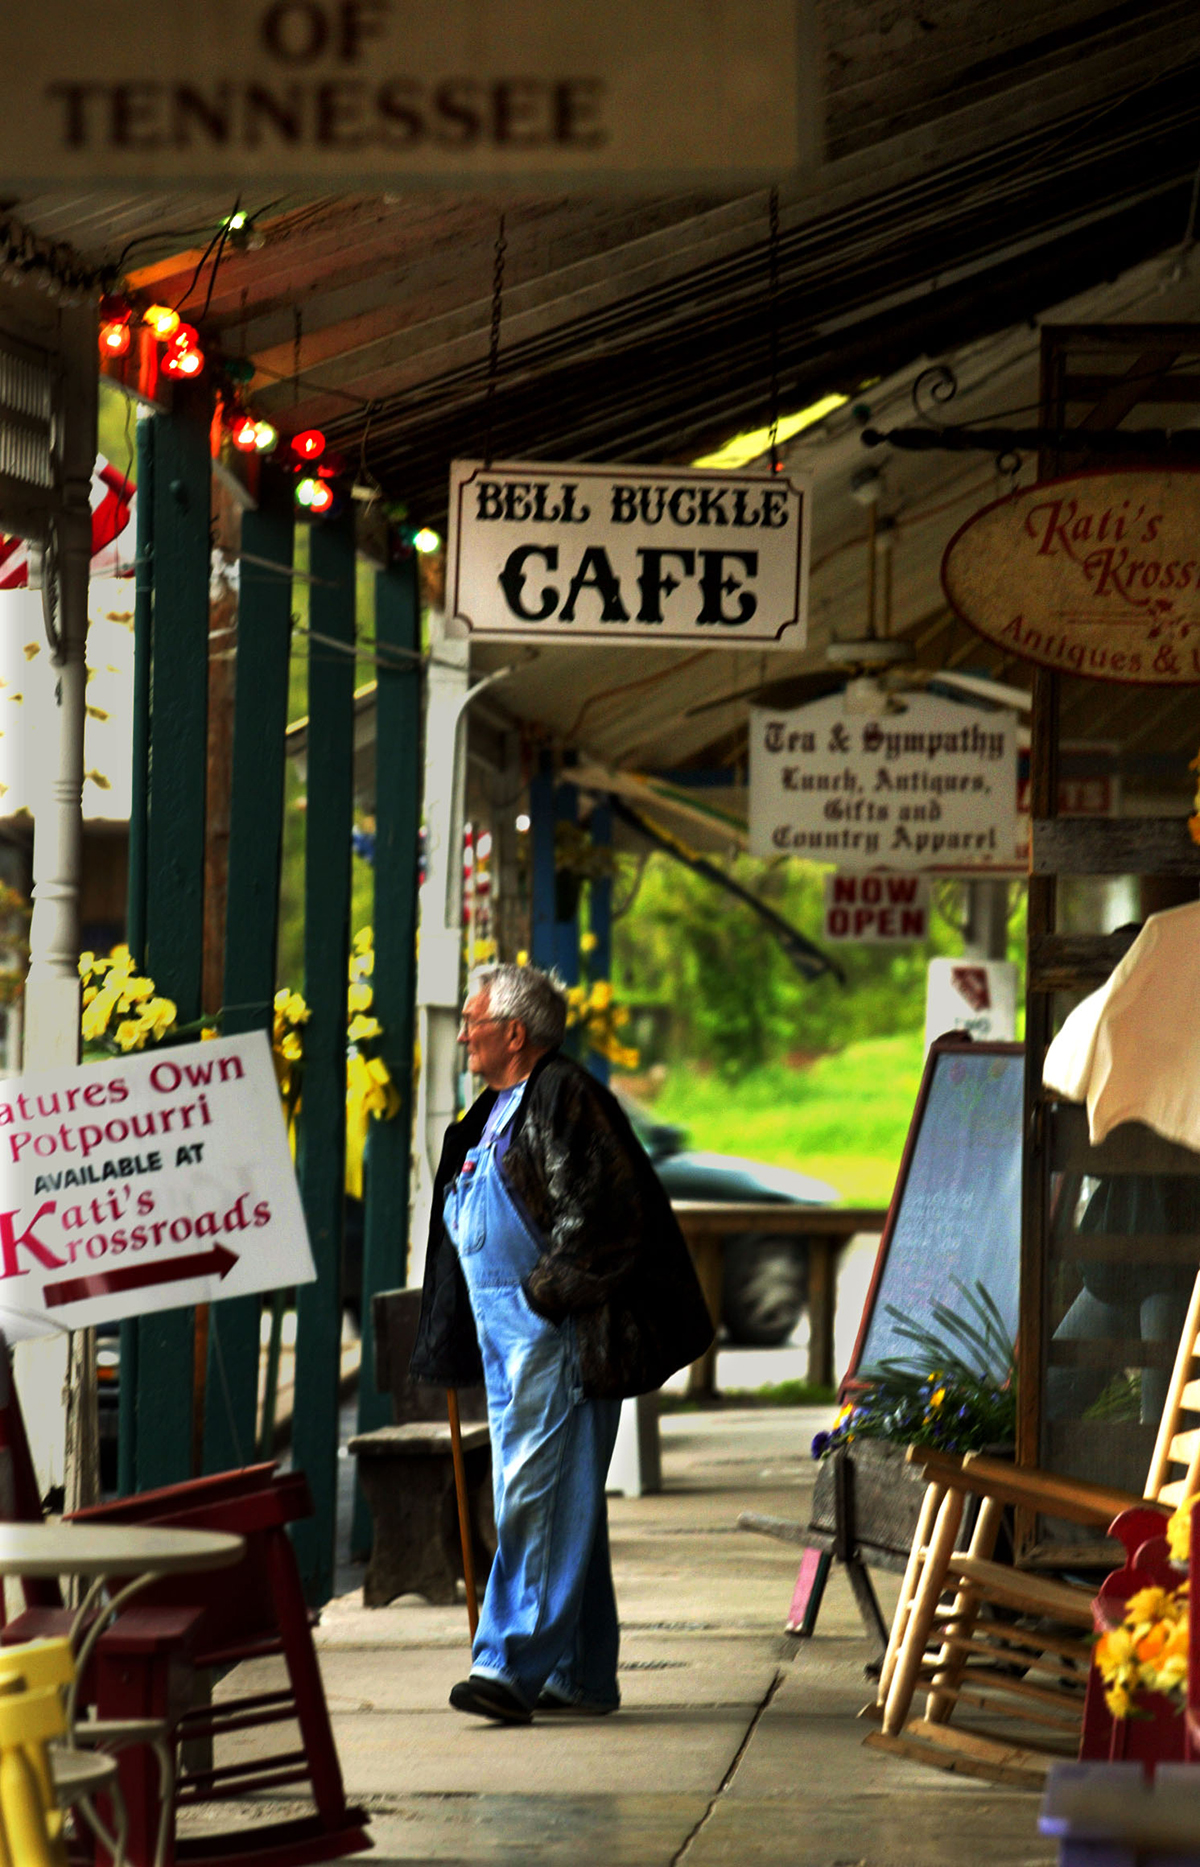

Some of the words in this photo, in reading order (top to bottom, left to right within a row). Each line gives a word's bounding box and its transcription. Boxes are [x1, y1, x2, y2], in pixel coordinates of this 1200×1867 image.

[257, 0, 385, 66] OF
[44, 76, 608, 152] TENNESSEE
[475, 481, 590, 524] BELL
[610, 484, 790, 529] BUCKLE
[1024, 499, 1164, 567] Kati's
[498, 544, 759, 626] CAFE
[1083, 546, 1200, 607] Kross
[1001, 613, 1142, 671] Antiques
[1152, 644, 1182, 675] &
[763, 721, 816, 754] Tea
[828, 721, 849, 754] &
[862, 720, 1005, 760] Sympathy
[781, 766, 864, 794] Lunch,
[873, 768, 992, 797] Antiques,
[823, 799, 889, 821] Gifts
[898, 799, 942, 822] and
[772, 825, 880, 854] Country
[891, 825, 997, 854] Apparel
[833, 876, 918, 905] NOW
[827, 908, 925, 938] OPEN
[149, 1054, 245, 1093] Own
[9, 1093, 213, 1163] Potpourri
[34, 1150, 163, 1195] AVAILABLE
[175, 1142, 205, 1167] AT
[0, 1184, 155, 1279] Kati's
